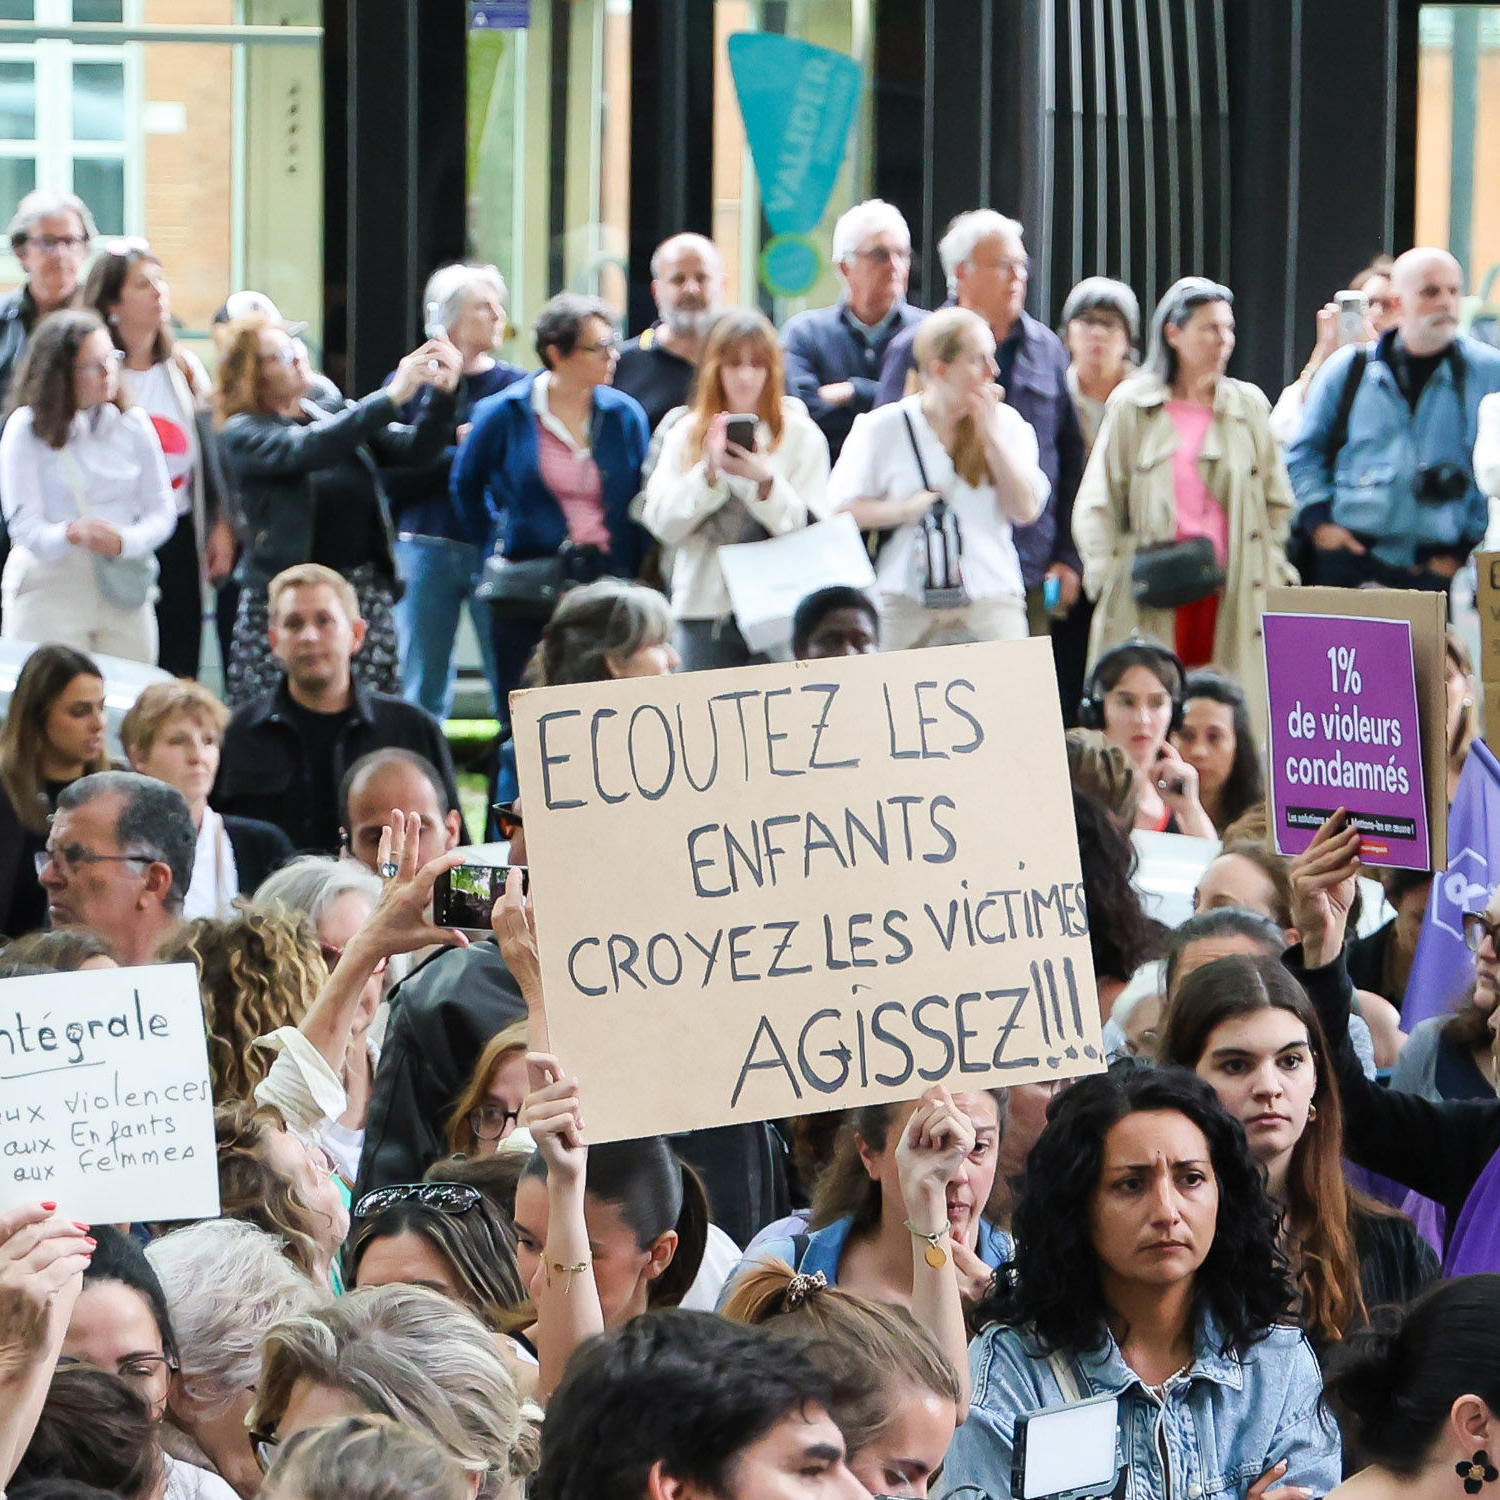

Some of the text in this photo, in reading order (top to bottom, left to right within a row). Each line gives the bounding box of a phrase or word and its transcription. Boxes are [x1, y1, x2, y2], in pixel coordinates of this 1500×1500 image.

[1326, 646, 1362, 695] 1%
[537, 679, 985, 811] ECOUTEZ LES
[1287, 700, 1402, 748] de violeurs
[1285, 749, 1410, 795] condamnés
[687, 795, 958, 899] ENFANTS
[567, 920, 814, 997] CROYEZ
[823, 909, 913, 970] LES
[64, 1070, 211, 1115] violences
[3, 1135, 57, 1157] aux
[70, 1114, 177, 1152] Enfants
[13, 1164, 55, 1182] aux
